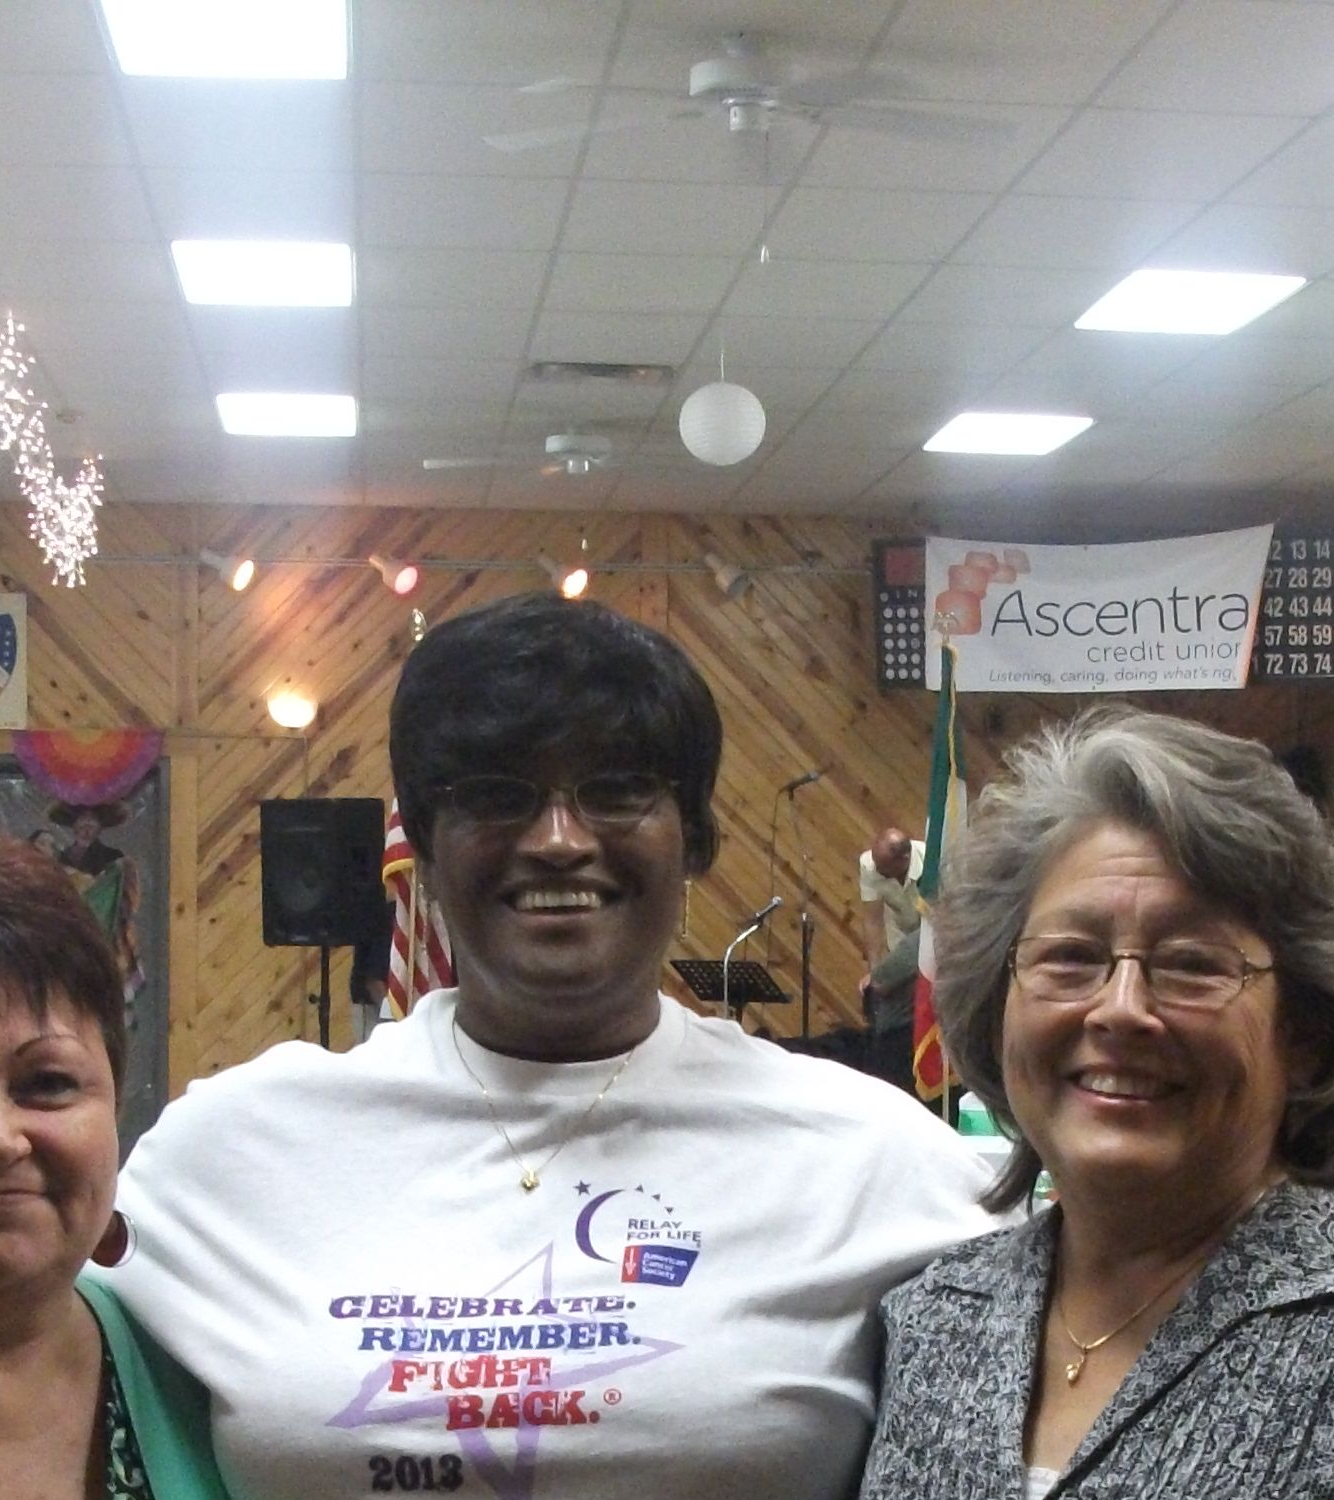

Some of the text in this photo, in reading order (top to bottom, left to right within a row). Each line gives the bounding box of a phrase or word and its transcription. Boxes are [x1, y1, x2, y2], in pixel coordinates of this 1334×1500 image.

[1291, 539, 1307, 560] 13
[1314, 538, 1330, 560] 14
[1288, 567, 1308, 588] 28
[1312, 566, 1332, 588] 29
[991, 587, 1249, 637] Ascentra
[1264, 597, 1283, 618] 42
[1289, 596, 1309, 617] 43
[1313, 596, 1332, 617] 44
[1265, 625, 1283, 646] 57
[1288, 625, 1308, 646] 58
[1313, 624, 1332, 645] 59
[1086, 641, 1165, 663] credit
[1265, 654, 1284, 674] 72
[1289, 654, 1308, 674] 73
[1314, 653, 1332, 674] 74
[989, 669, 1055, 686] Listening,
[1060, 669, 1109, 686] caring,
[1114, 668, 1157, 685] doing
[1163, 666, 1208, 682] what's
[628, 1218, 682, 1230] RELAY
[627, 1230, 701, 1243] FOR LIFE
[328, 1295, 637, 1320] CELEBRATE.
[358, 1321, 641, 1352] REMEMBER.
[388, 1354, 552, 1392] FIGHT
[369, 1453, 464, 1492] 2013
